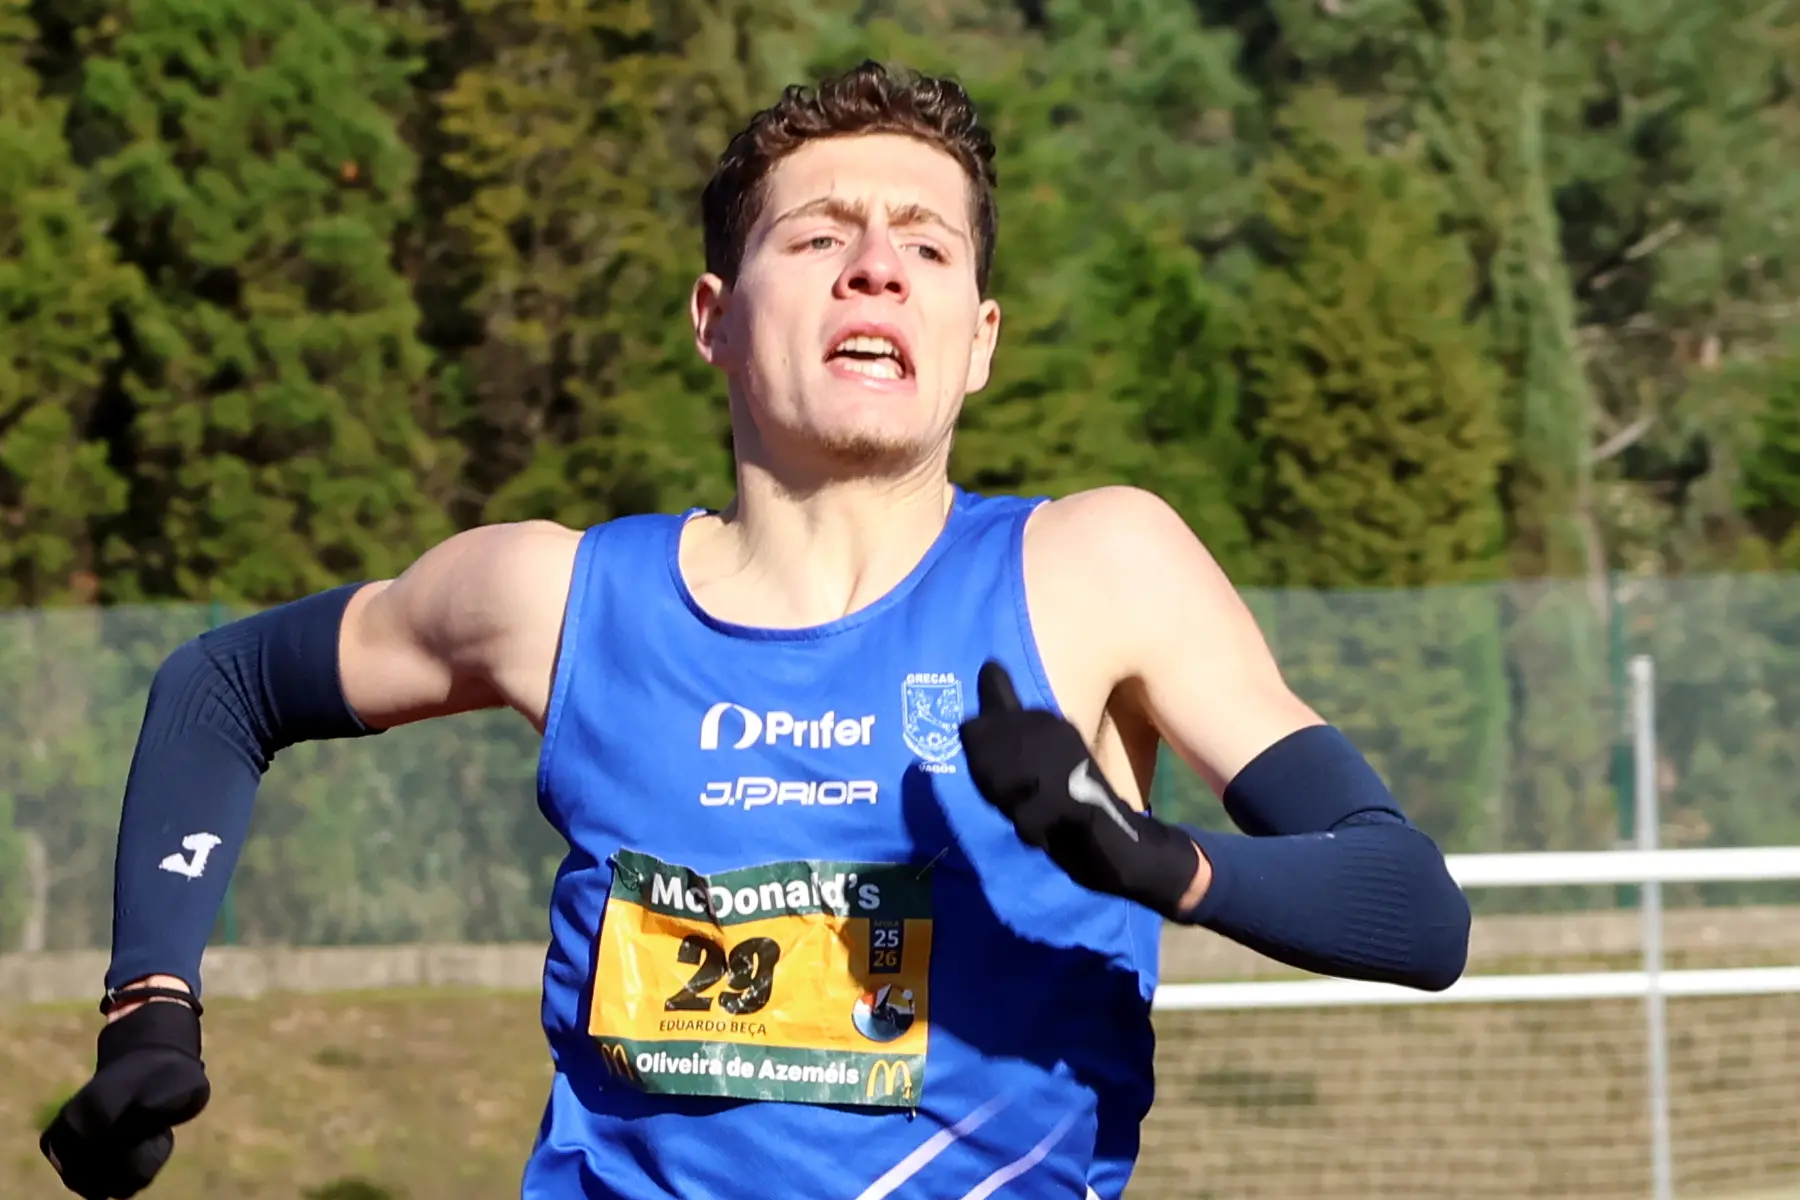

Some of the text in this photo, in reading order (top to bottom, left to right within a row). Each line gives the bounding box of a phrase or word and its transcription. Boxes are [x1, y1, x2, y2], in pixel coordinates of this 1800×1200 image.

[650, 872, 881, 920] McDonald's
[874, 929, 899, 948] 25
[873, 950, 898, 967] 26
[664, 934, 781, 1016] 29
[659, 1019, 768, 1037] EDUARDO BEÇA
[635, 1051, 861, 1085] Oliveira de Azeméis
